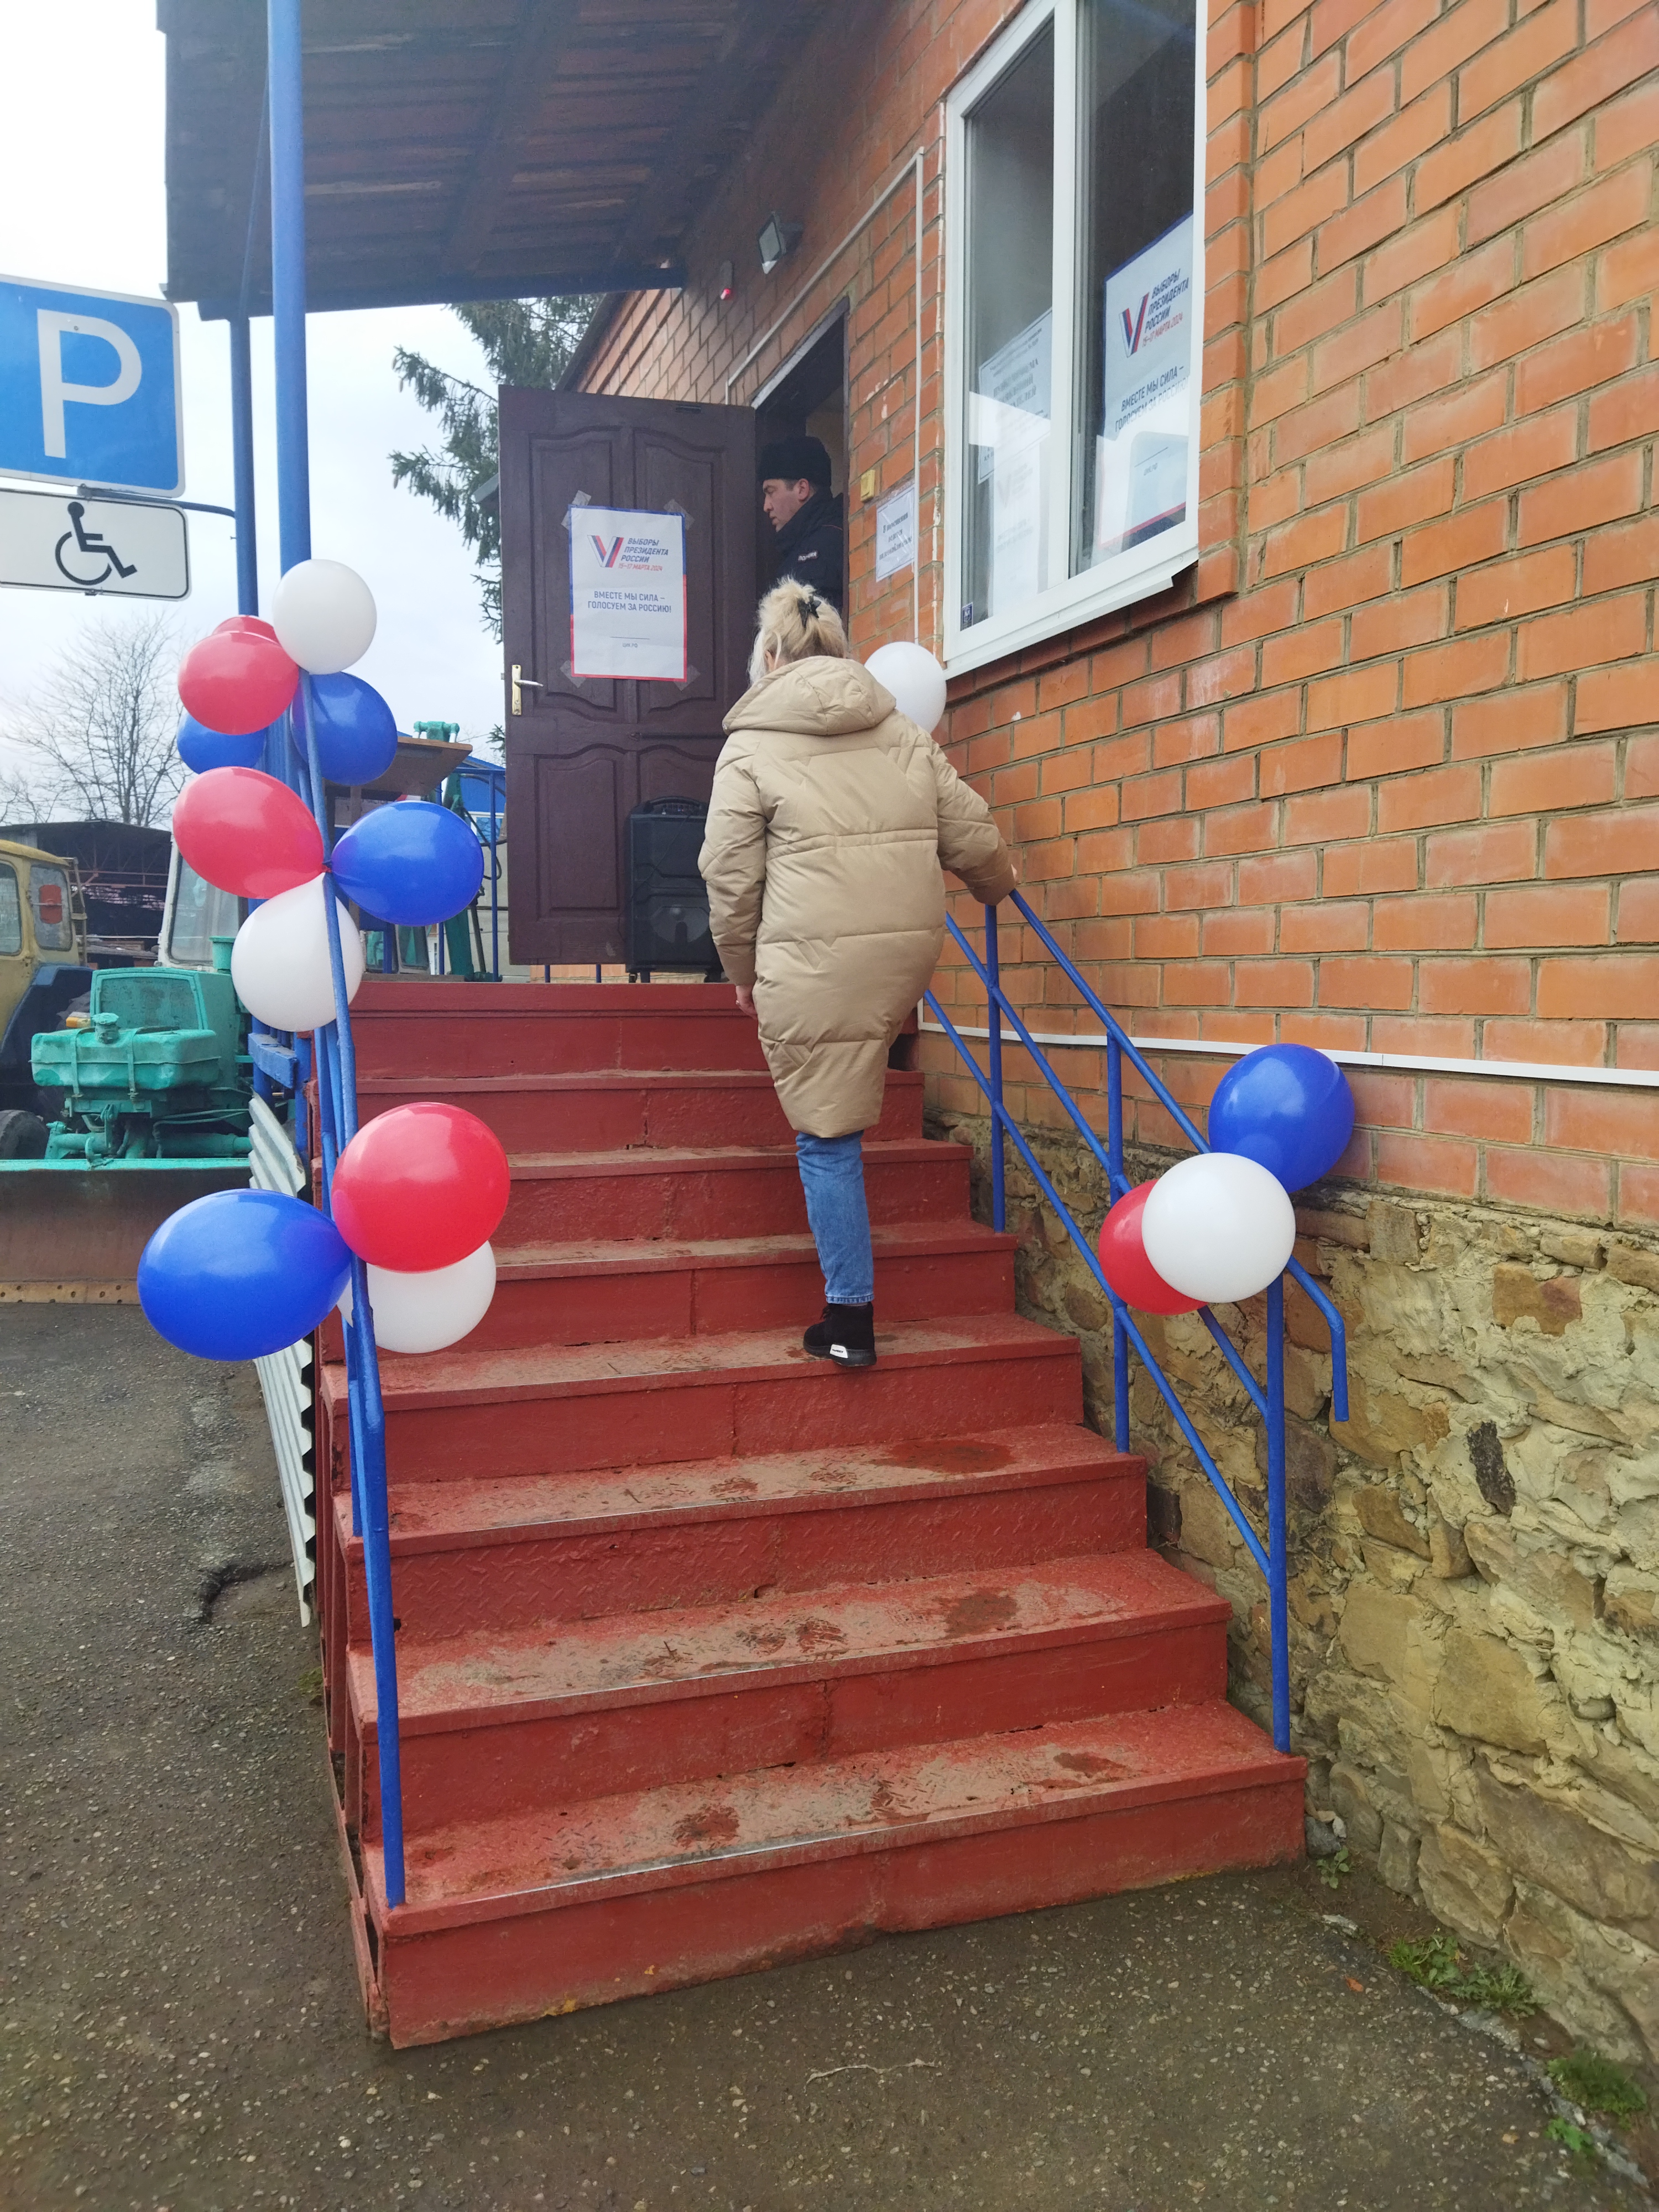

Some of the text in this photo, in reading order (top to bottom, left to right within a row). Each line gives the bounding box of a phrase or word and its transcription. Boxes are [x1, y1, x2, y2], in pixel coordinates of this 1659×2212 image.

[1151, 268, 1181, 299] ВЫБОРЫ
[1147, 277, 1189, 317] ПРЕЗИДЕНТА
[1144, 305, 1171, 333] РОССИИ
[36, 308, 143, 458] P
[1121, 386, 1145, 412] ВМЕСТЕ
[1146, 378, 1159, 396] МЫ
[1160, 366, 1177, 388] СИЛА
[624, 546, 669, 556] ПРЕЗИДЕНТА
[627, 538, 660, 546] ВЫБОРЫ
[620, 555, 650, 563] РОССИИ
[594, 591, 623, 600] ВМЕСТЕ
[624, 592, 638, 601] МЫ
[639, 593, 659, 602] СИЛА
[587, 601, 672, 613] ГОЛОСУЕМ ЗА РОССИЮ!
